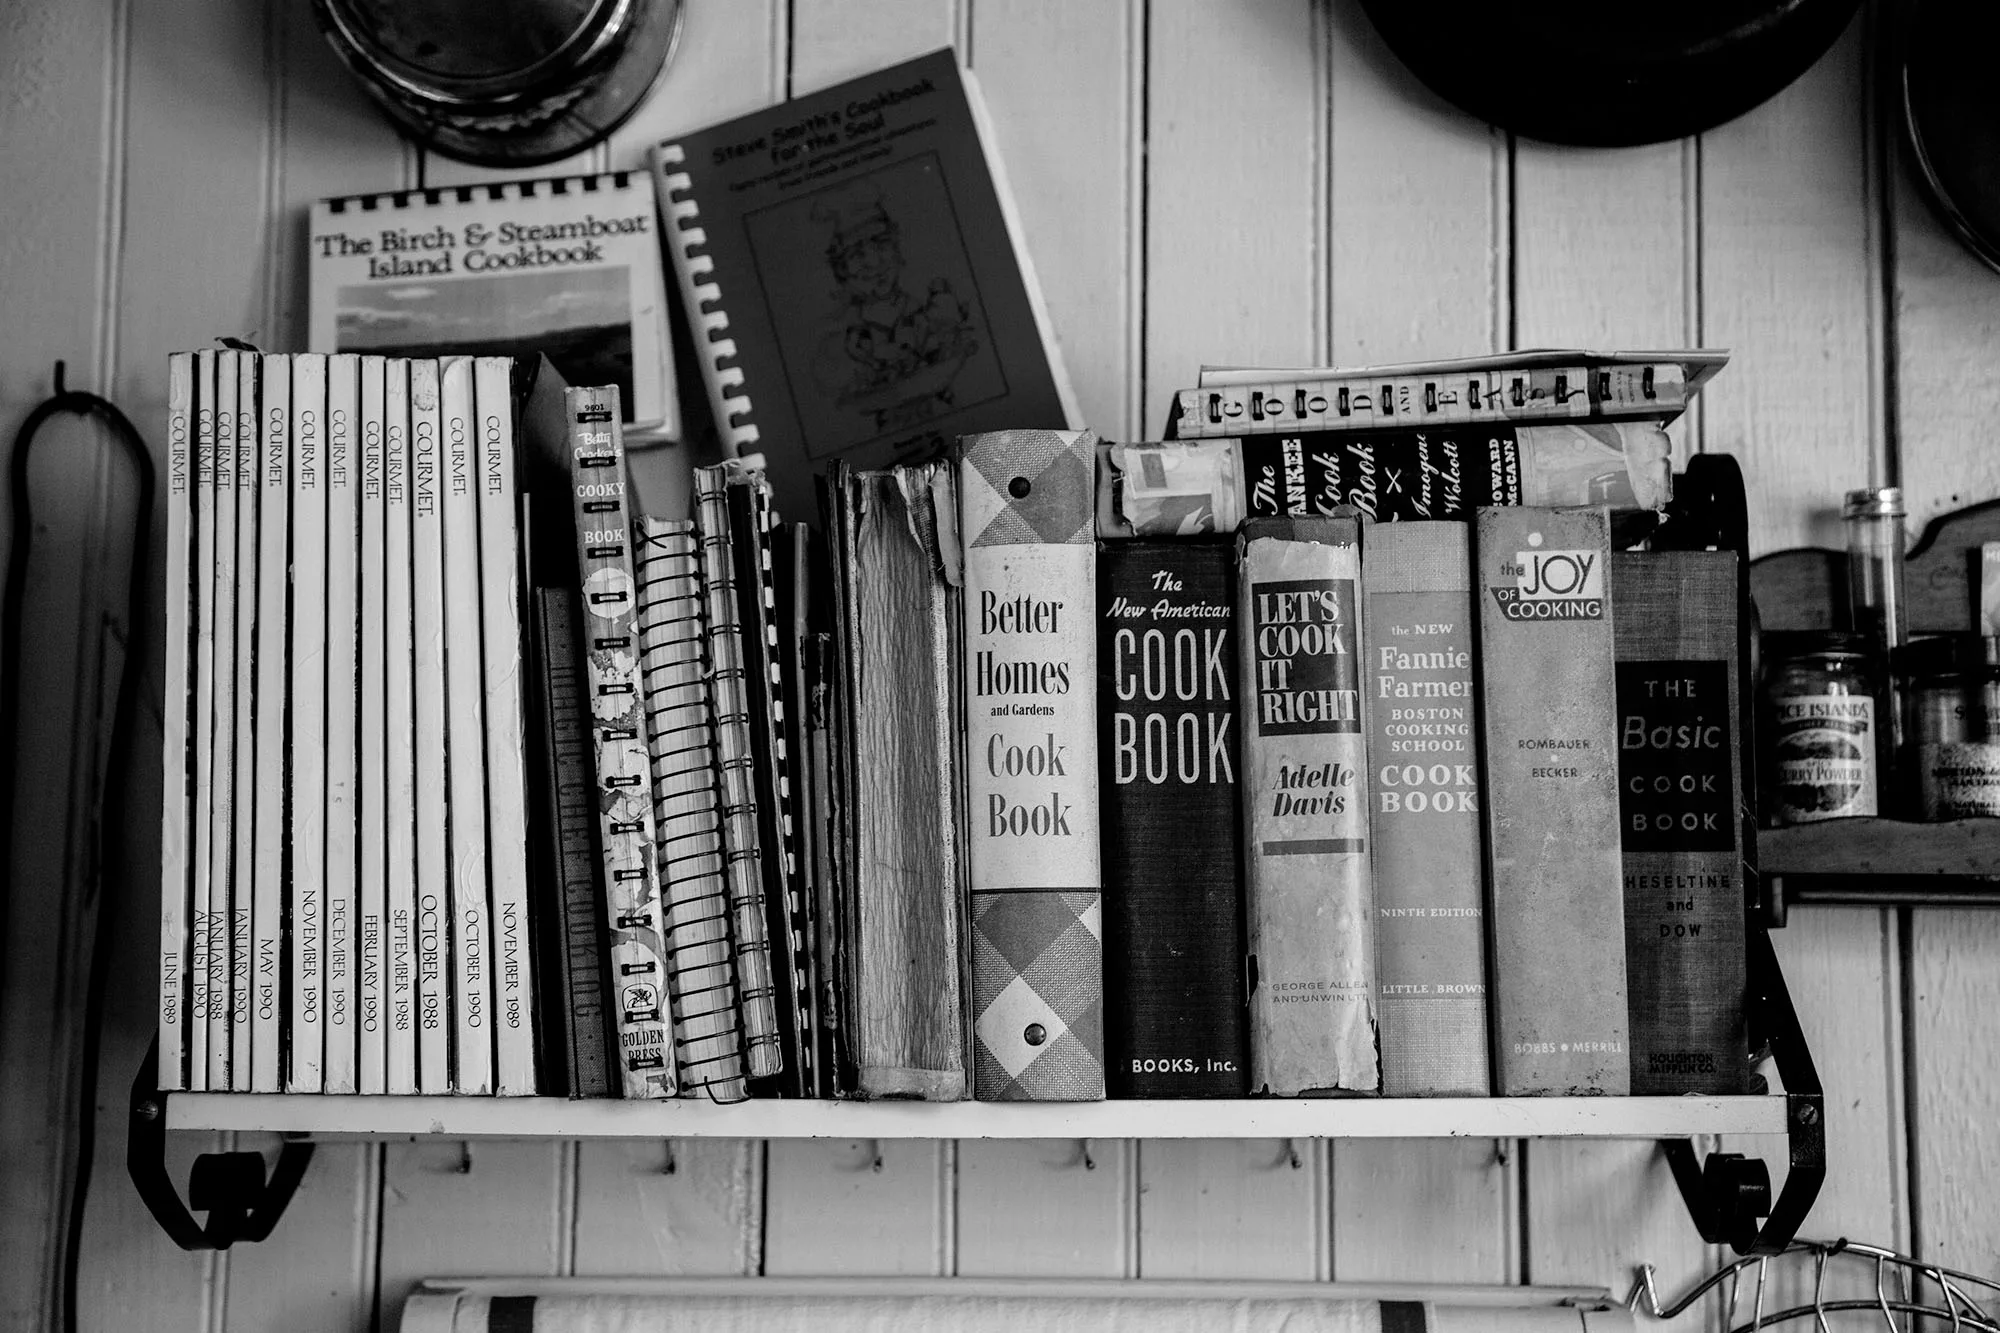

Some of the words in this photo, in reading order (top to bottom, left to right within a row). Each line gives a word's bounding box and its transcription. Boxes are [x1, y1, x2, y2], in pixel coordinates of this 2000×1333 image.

[845, 78, 936, 118] Cookbook
[314, 233, 373, 257] The
[379, 225, 455, 252] Birch
[464, 223, 494, 247] &
[499, 214, 650, 245] Steamboat
[368, 251, 453, 280] Island
[463, 241, 603, 273] Cookbook
[1400, 386, 1411, 414] AND
[577, 431, 611, 447] Betty
[1252, 464, 1278, 516] The
[1282, 438, 1307, 517] ANKEE
[1347, 442, 1378, 523] Book
[1411, 433, 1439, 519] Imogene
[1443, 440, 1462, 515] Wolcott
[1489, 438, 1503, 507] OWARD
[576, 482, 625, 497] COOKY
[584, 528, 625, 544] BOOK
[1151, 570, 1182, 592] The
[1500, 561, 1525, 577] the
[1523, 554, 1595, 595] JOY
[1106, 598, 1146, 618] New
[1151, 599, 1231, 619] American
[1258, 590, 1340, 625] LET'S
[1498, 590, 1517, 600] OF
[1507, 601, 1601, 618] COOKING
[980, 590, 1063, 635] Better
[1259, 623, 1348, 658] COOK
[1391, 625, 1409, 636] the
[1415, 624, 1453, 635] NEW
[976, 650, 1070, 696] Homes
[1114, 628, 1230, 701] COOK
[1379, 646, 1469, 670] Fannie
[1259, 659, 1292, 691] IT
[1378, 676, 1473, 699] Farmer
[1644, 679, 1696, 698] THE
[990, 704, 1009, 716] and
[1012, 703, 1055, 716] Gardens
[1259, 690, 1358, 724] RIGHT
[1391, 708, 1464, 720] BOSTON
[1385, 723, 1469, 736] COOKING
[1391, 740, 1464, 752] SCHOOL
[1518, 739, 1590, 750] ROMBAUER
[1622, 716, 1721, 750] Basic
[987, 732, 1067, 777] Cook
[1115, 712, 1235, 785] BOOK
[1272, 763, 1355, 790] Adelle
[1379, 764, 1475, 787] COOK
[1532, 768, 1578, 778] BECKER
[1630, 775, 1716, 793] COOK
[988, 792, 1072, 837] Book
[1272, 791, 1345, 817] Davis
[1380, 791, 1479, 813] BOOK
[560, 783, 590, 861] CHEF
[1633, 813, 1718, 831] BOOK
[1625, 875, 1730, 889] HESELTINE
[1381, 908, 1425, 917] NINTH
[1430, 908, 1482, 917] EDITION
[1666, 897, 1693, 911] and
[194, 910, 208, 971] AUGUST
[210, 911, 224, 983] JANUARY
[235, 908, 248, 980] JANUARY
[303, 890, 316, 979] NOVEMBER
[332, 899, 346, 980] DECEMBER
[421, 894, 438, 984] OCTOBER
[465, 910, 480, 984] OCTOBER
[503, 902, 519, 992] NOVEMBER
[1660, 924, 1700, 937] DOW
[260, 939, 274, 976] MAY
[364, 915, 378, 990] FEBRUARY
[394, 909, 408, 994] SEPTEMBER
[566, 880, 602, 1018] COOKING
[163, 951, 177, 989] JUNE
[1272, 982, 1325, 991] GEORGE
[1329, 981, 1368, 990] ALLEN
[193, 983, 207, 1018] 1990
[210, 986, 223, 1020] 1988
[234, 985, 247, 1023] 1990
[259, 982, 272, 1020] 1990
[303, 985, 316, 1023] 1990
[1273, 995, 1299, 1003] AND
[1302, 994, 1344, 1002] UNWIN
[1437, 984, 1485, 994] BROWN
[163, 993, 176, 1024] 1989
[332, 988, 345, 1025] 1990
[364, 994, 377, 1032] 1990
[395, 998, 409, 1031] 1988
[423, 991, 439, 1029] 1988
[468, 990, 481, 1028] 1990
[506, 996, 520, 1029] 1989
[622, 1029, 664, 1047] GOLDEN
[628, 1047, 661, 1060] PRESS
[1514, 1042, 1556, 1054] BOBBS
[1572, 1042, 1623, 1053] MERRILL
[1132, 1058, 1200, 1074] BOOKS,
[1206, 1057, 1238, 1072] Inc.
[1649, 1053, 1713, 1063] HOUGHTON
[1650, 1063, 1697, 1073] MIFFLIN
